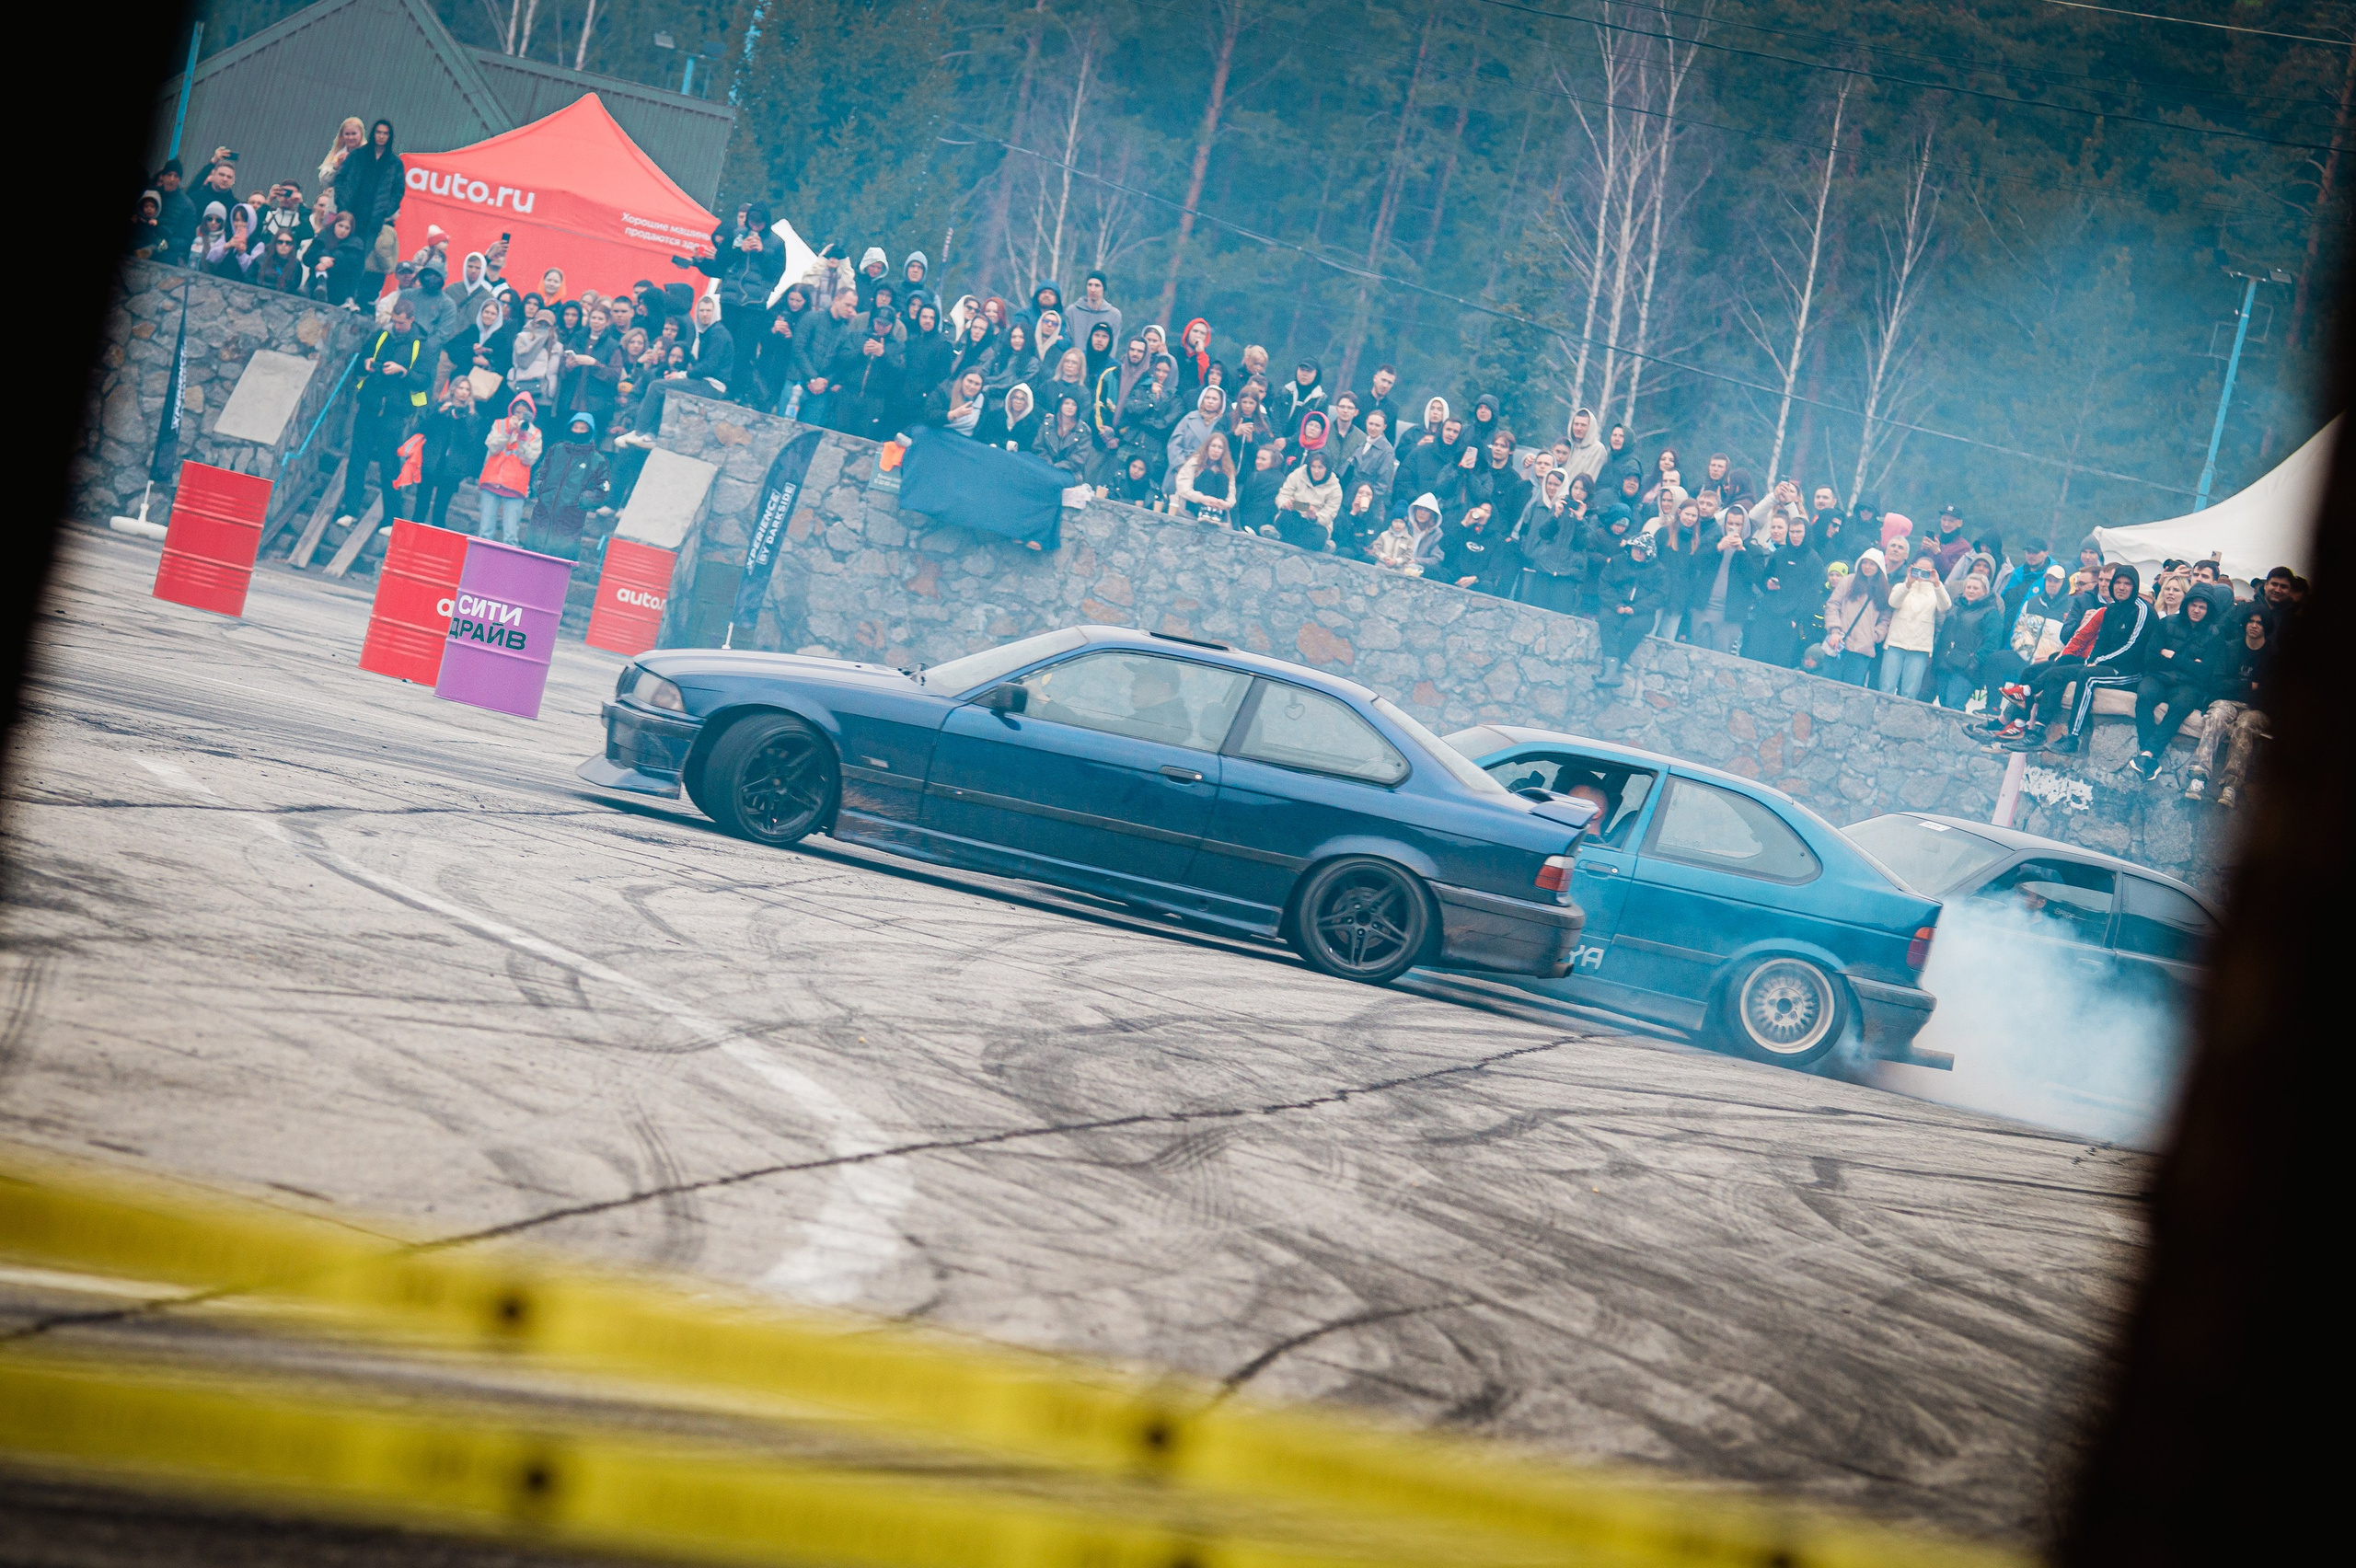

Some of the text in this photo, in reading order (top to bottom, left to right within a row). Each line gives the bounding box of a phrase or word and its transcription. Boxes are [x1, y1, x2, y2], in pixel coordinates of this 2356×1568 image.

[405, 167, 536, 213] auto.ru
[621, 212, 669, 232] Хорошие
[625, 227, 680, 246] продаются
[758, 484, 793, 562] BY DARKSIDE
[458, 594, 523, 627] СИТИ
[449, 617, 527, 651] ДРАЙВ
